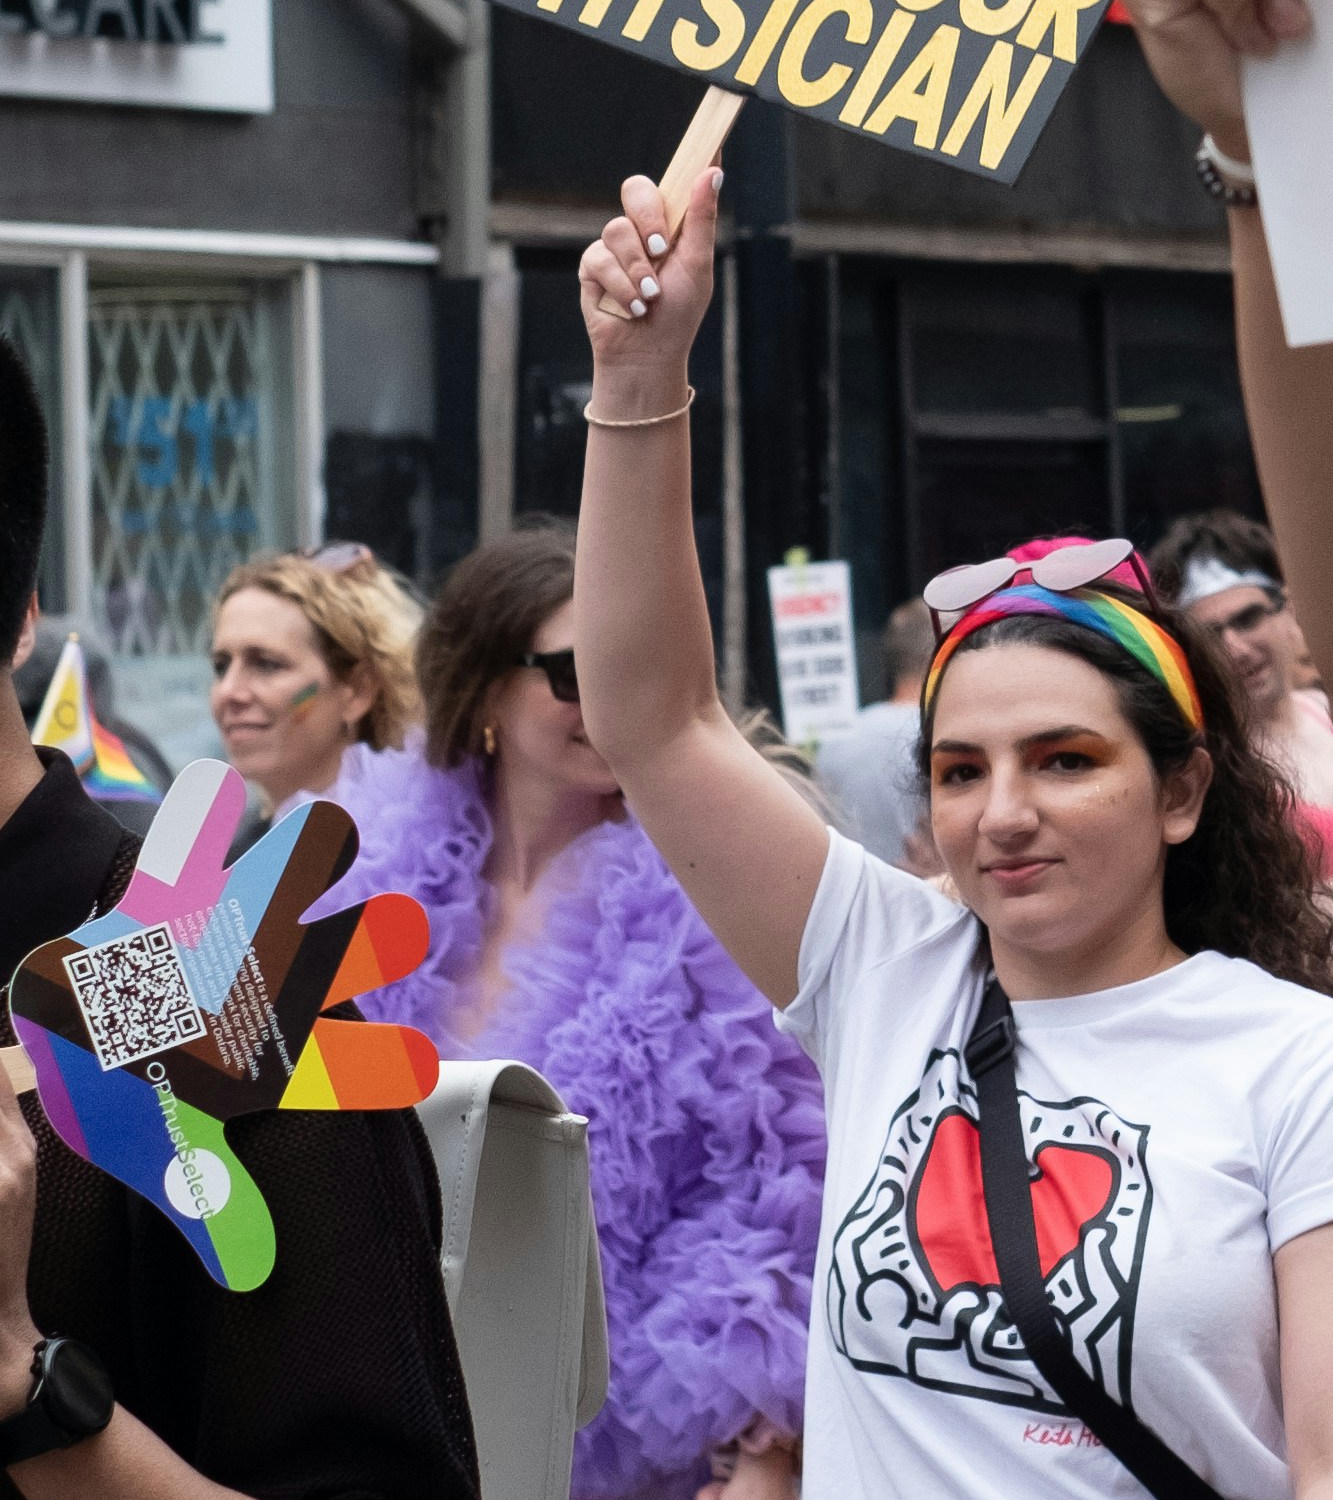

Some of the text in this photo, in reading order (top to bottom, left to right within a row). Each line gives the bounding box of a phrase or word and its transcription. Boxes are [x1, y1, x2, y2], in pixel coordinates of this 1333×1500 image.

[227, 897, 252, 946] OPTrust
[244, 946, 265, 983] Select
[263, 1001, 283, 1039] defined
[237, 1001, 259, 1041] security
[252, 1041, 264, 1056] for
[242, 982, 266, 1029] designed
[224, 1039, 246, 1072] public
